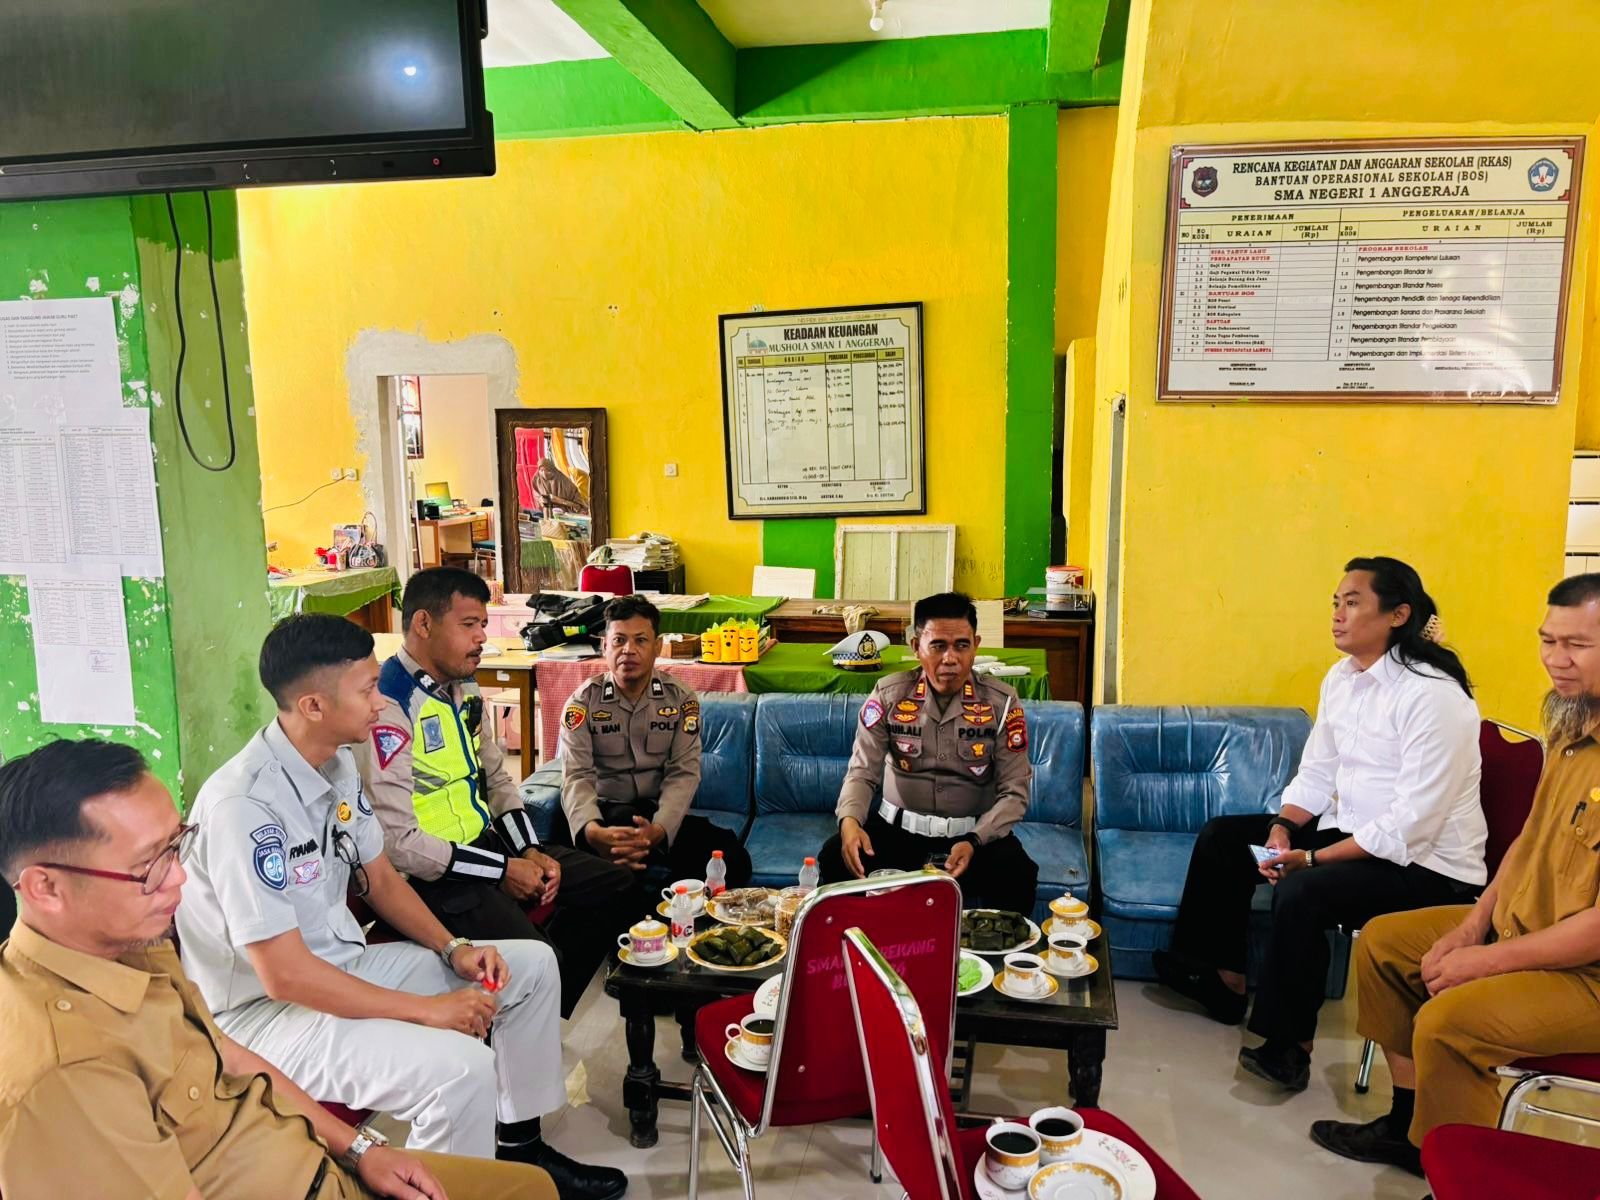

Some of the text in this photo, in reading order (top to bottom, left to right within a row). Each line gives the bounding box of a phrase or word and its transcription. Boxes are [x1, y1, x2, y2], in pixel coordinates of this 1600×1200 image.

[1232, 155, 1512, 174] RENCANA KEGIATAN DAN ANGGARAN SEKOLAH (RKAS)
[1255, 170, 1489, 186] BANTUAN OPERASIONAL SEKOLAH (BOS)
[1274, 185, 1470, 201] SMA NEGERI 1 ANGGERAJA
[1402, 208, 1526, 217] PENGELUARAN/BELANJA
[1231, 213, 1295, 222] PENERIMAAN
[1293, 224, 1329, 232] JUMLAH
[1516, 220, 1553, 228] JUMLAH
[1227, 229, 1273, 238] URAIAN
[1301, 231, 1320, 239] (Rp)
[1526, 227, 1546, 235] (Rp)
[1357, 255, 1404, 263] Pengembangan
[1356, 269, 1402, 277] Pengembangan
[1352, 309, 1399, 317] Pengembangan
[1351, 323, 1398, 331] Pengembangan
[783, 323, 879, 341] KEADAAN KEUANGAN
[1350, 336, 1397, 344] Pengembangan
[768, 341, 809, 353] MUSHOLA
[811, 340, 836, 350] SMAN
[845, 337, 895, 348] ANGGERAJA
[1349, 350, 1395, 358] Pengembangan
